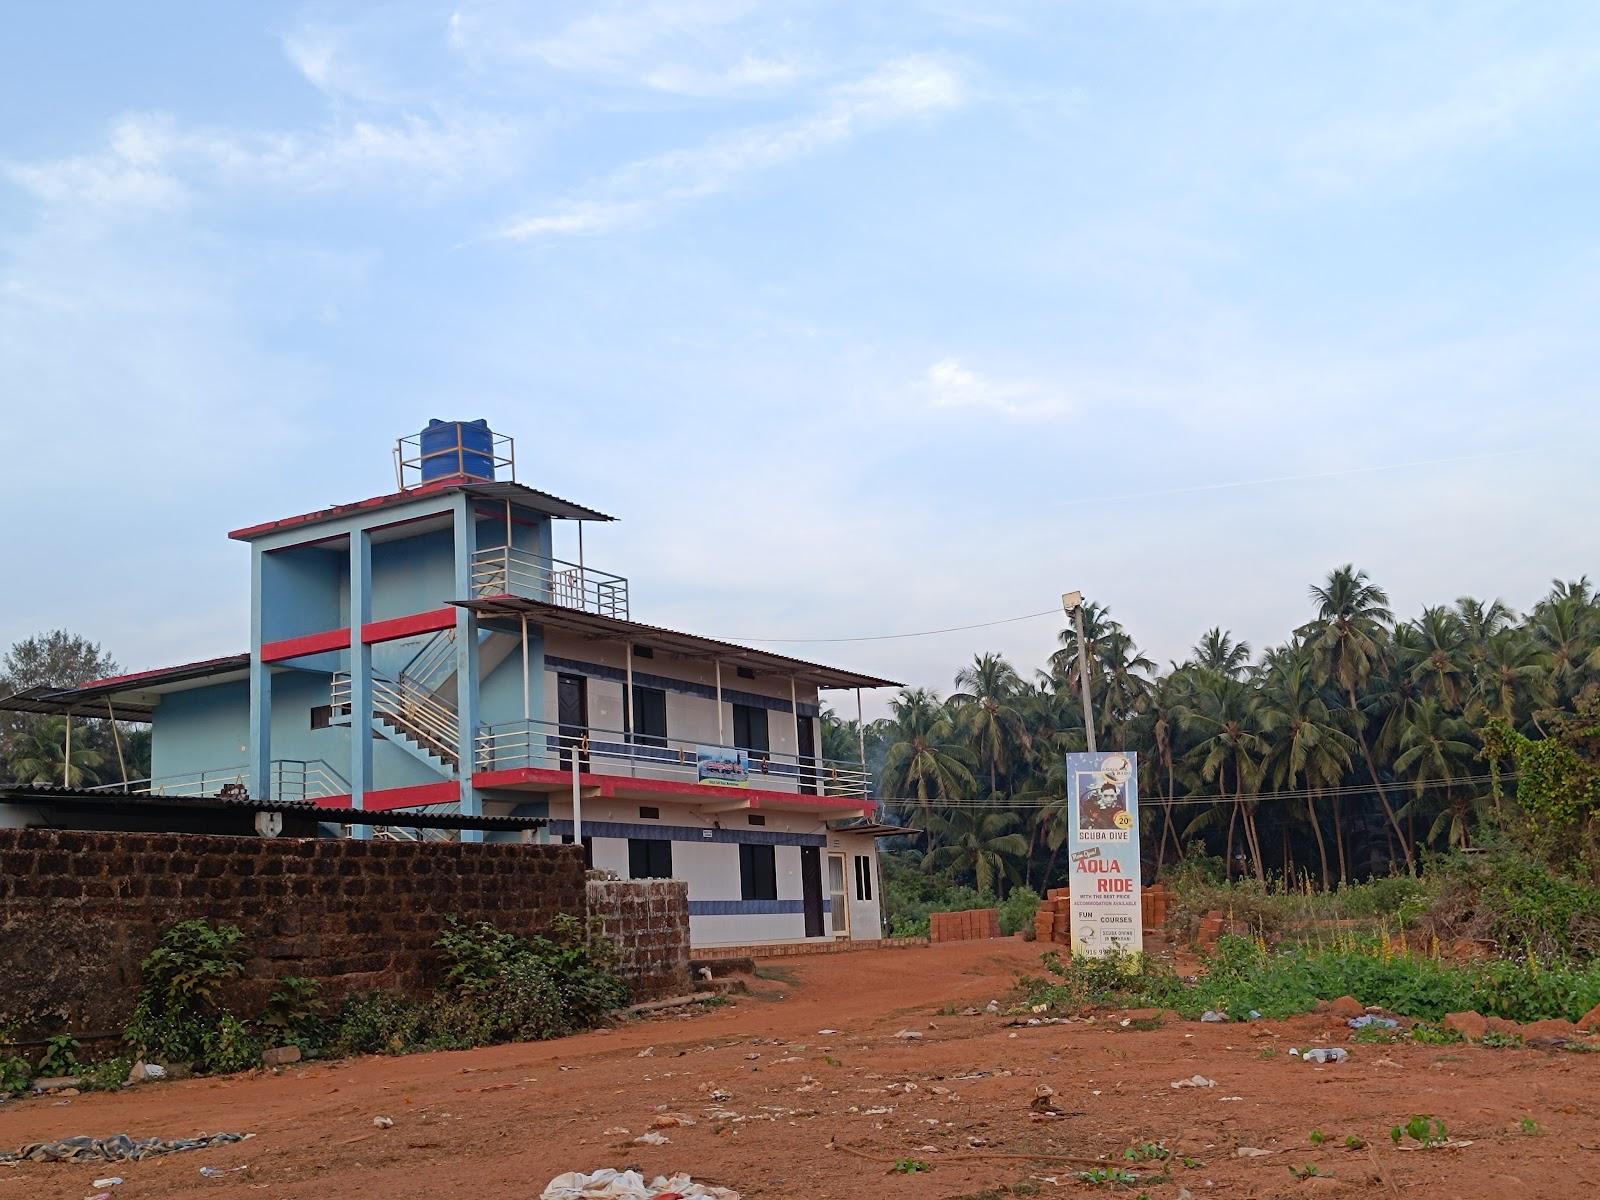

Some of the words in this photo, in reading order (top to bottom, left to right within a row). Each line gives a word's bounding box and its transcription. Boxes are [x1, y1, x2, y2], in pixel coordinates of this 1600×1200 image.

[1119, 817, 1129, 825] 20
[1079, 832, 1107, 840] SCUBA
[1109, 832, 1128, 840] DIVE
[1076, 857, 1121, 874] AQUA
[1097, 878, 1133, 893] RIDE
